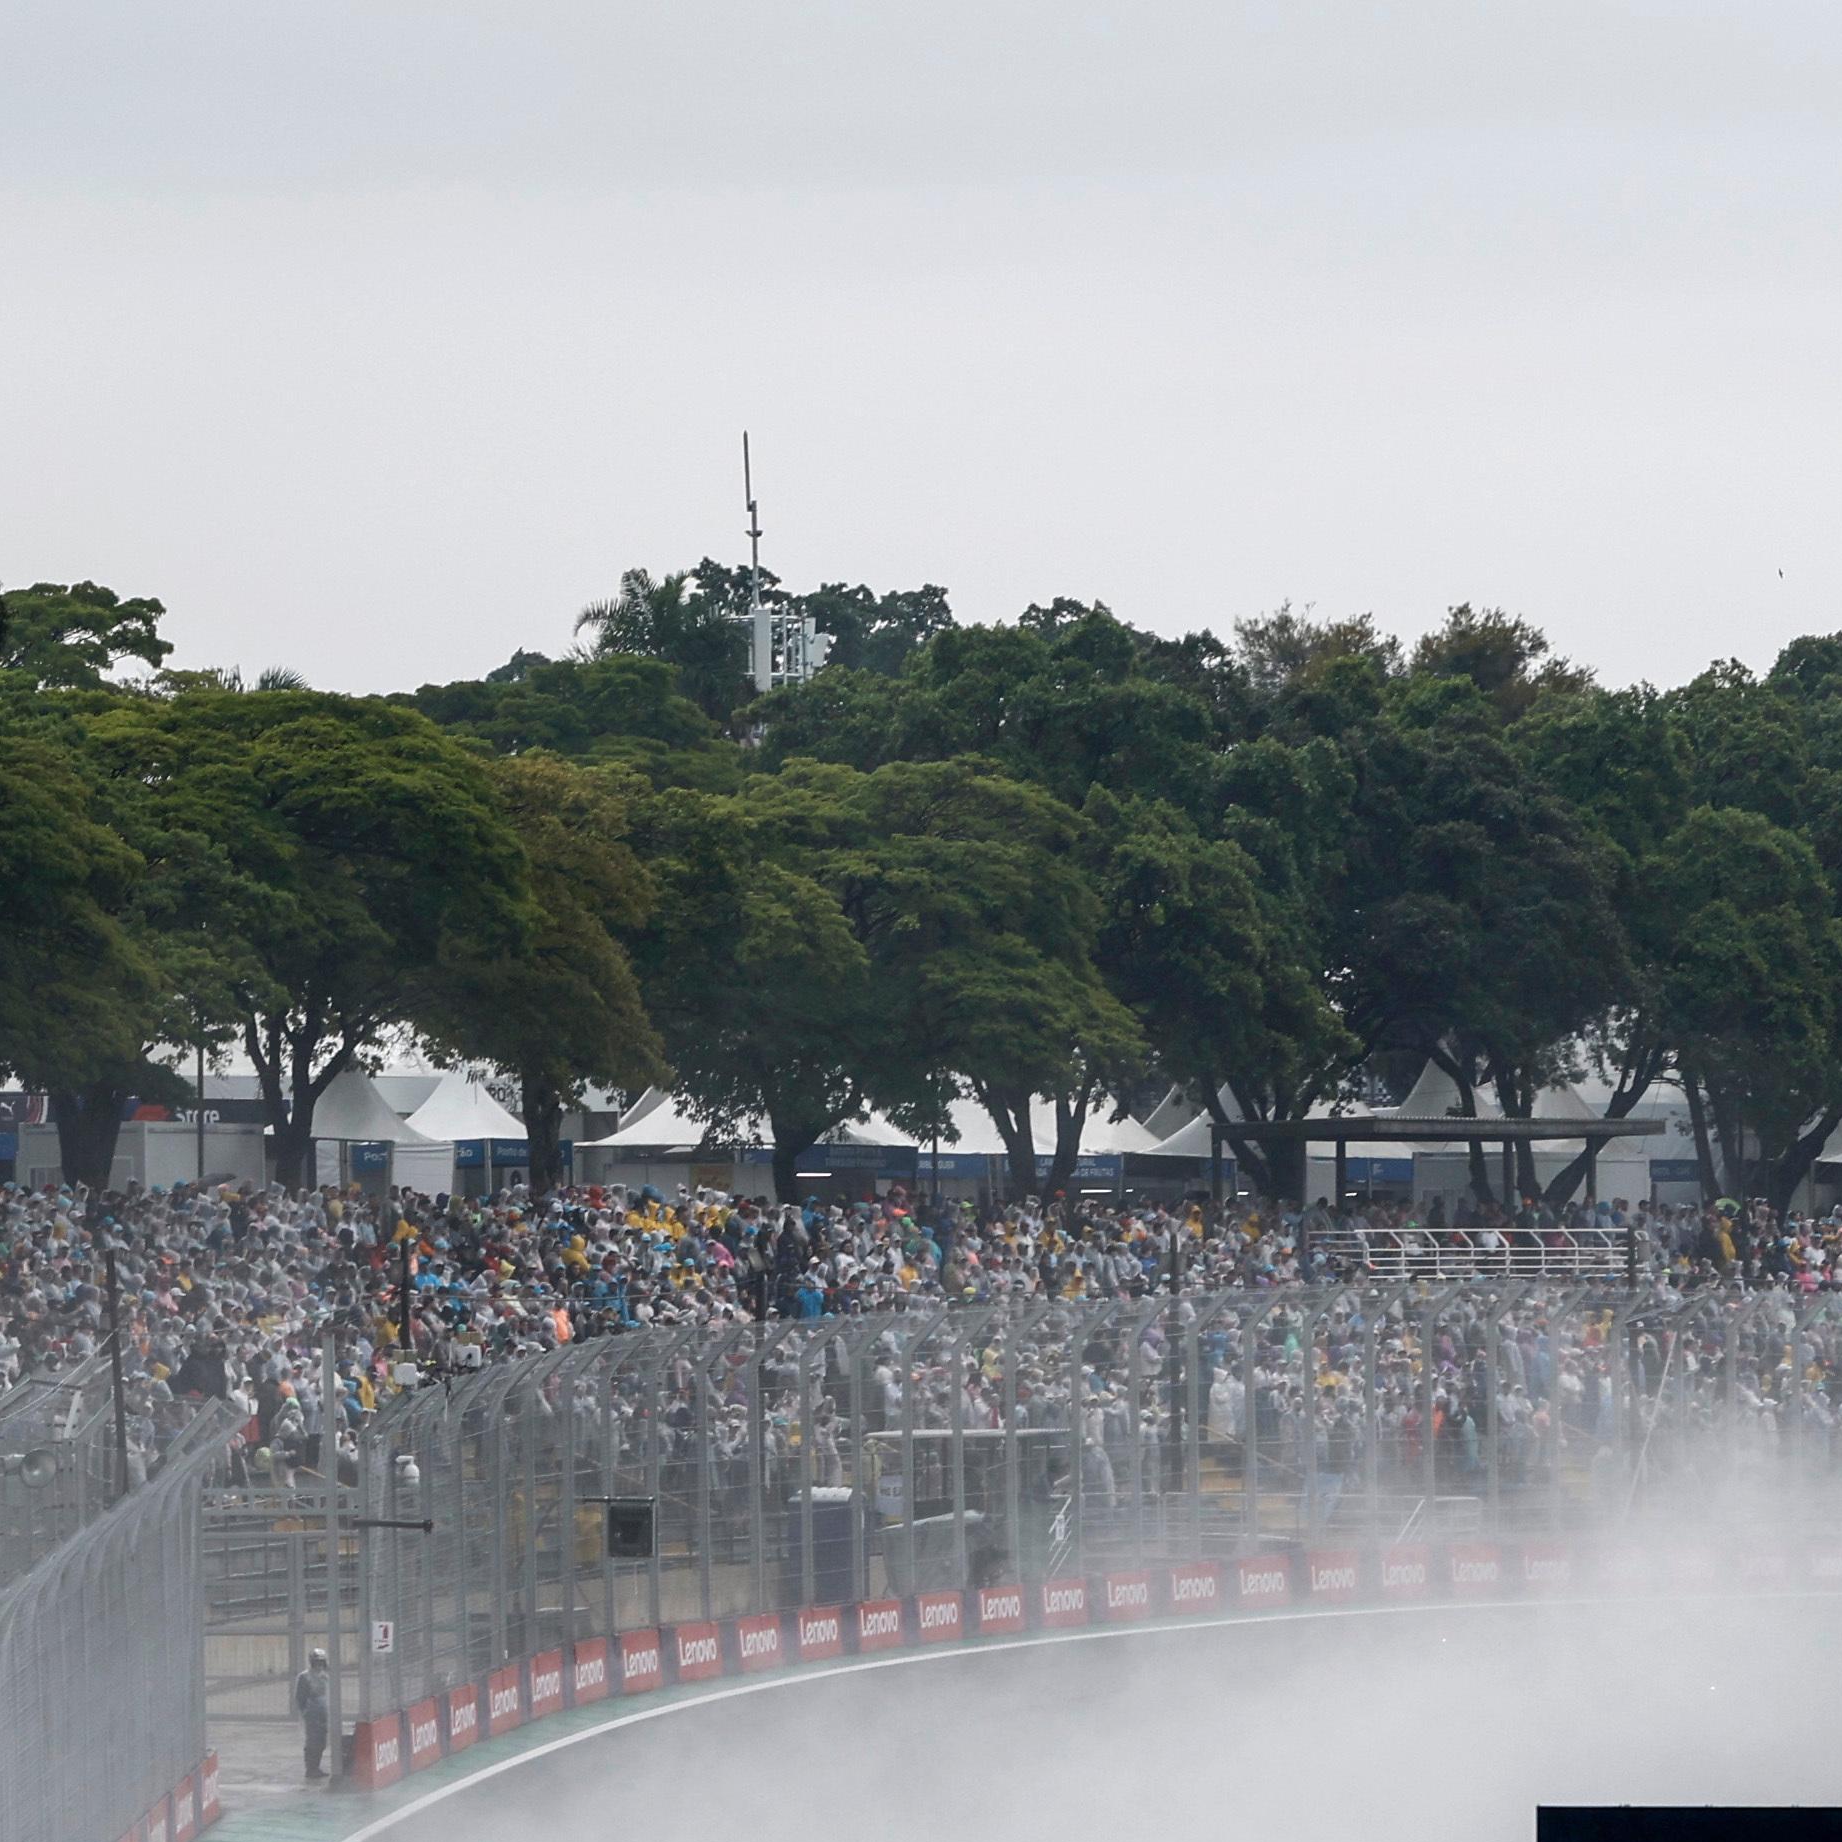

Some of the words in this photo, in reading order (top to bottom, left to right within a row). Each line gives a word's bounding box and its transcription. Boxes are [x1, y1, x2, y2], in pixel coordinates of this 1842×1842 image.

[1240, 1567, 1284, 1597] Lenovo
[1312, 1562, 1355, 1591] Lenovo
[1383, 1559, 1425, 1587] Lenovo
[1044, 1589, 1084, 1613] Lenovo
[1108, 1581, 1147, 1608] Lenovo
[1174, 1575, 1215, 1601] Lenovo
[920, 1600, 957, 1627] Lenovo
[981, 1594, 1019, 1620] Lenovo
[800, 1616, 838, 1644] Lenovo
[861, 1610, 898, 1636] Lenovo
[679, 1638, 717, 1666] Lenovo
[740, 1628, 777, 1656] Lenovo
[576, 1659, 603, 1689] Lenovo
[624, 1648, 657, 1679] Lenovo
[532, 1670, 558, 1700] Lenovo
[490, 1686, 517, 1718] Lenovo
[451, 1701, 476, 1735] Lenovo
[412, 1720, 436, 1754] Lenovo
[376, 1738, 397, 1771] Lenovo
